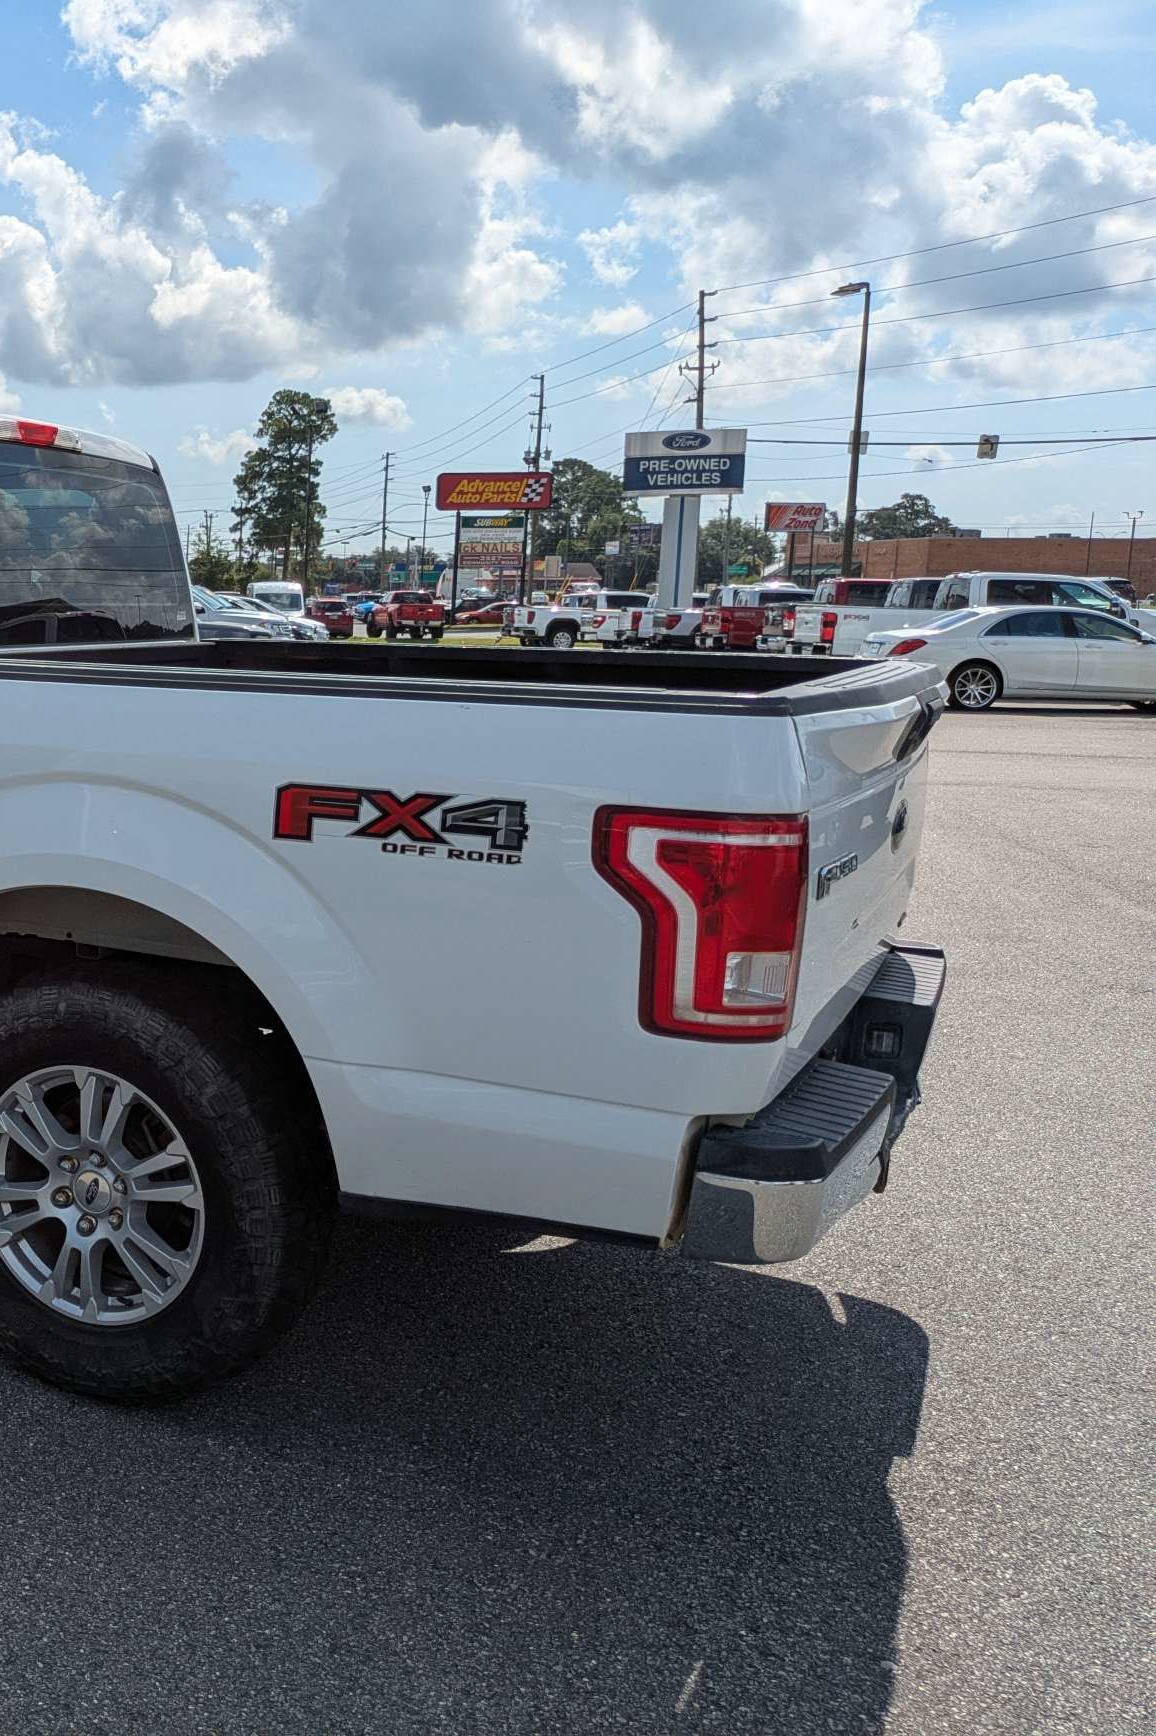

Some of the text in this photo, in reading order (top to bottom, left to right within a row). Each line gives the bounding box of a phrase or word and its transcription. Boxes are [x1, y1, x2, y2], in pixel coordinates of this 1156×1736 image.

[672, 435, 702, 447] Ford
[639, 458, 730, 473] PRE-OWNED
[647, 472, 721, 486] VEHICLES
[455, 479, 521, 492] Advance
[446, 491, 517, 503] Auto Parts
[793, 505, 822, 516] Auto
[474, 518, 512, 527] SUBWAY
[481, 543, 520, 553] NAILS
[272, 783, 530, 852] FX4
[381, 842, 522, 865] OFF ROAD
